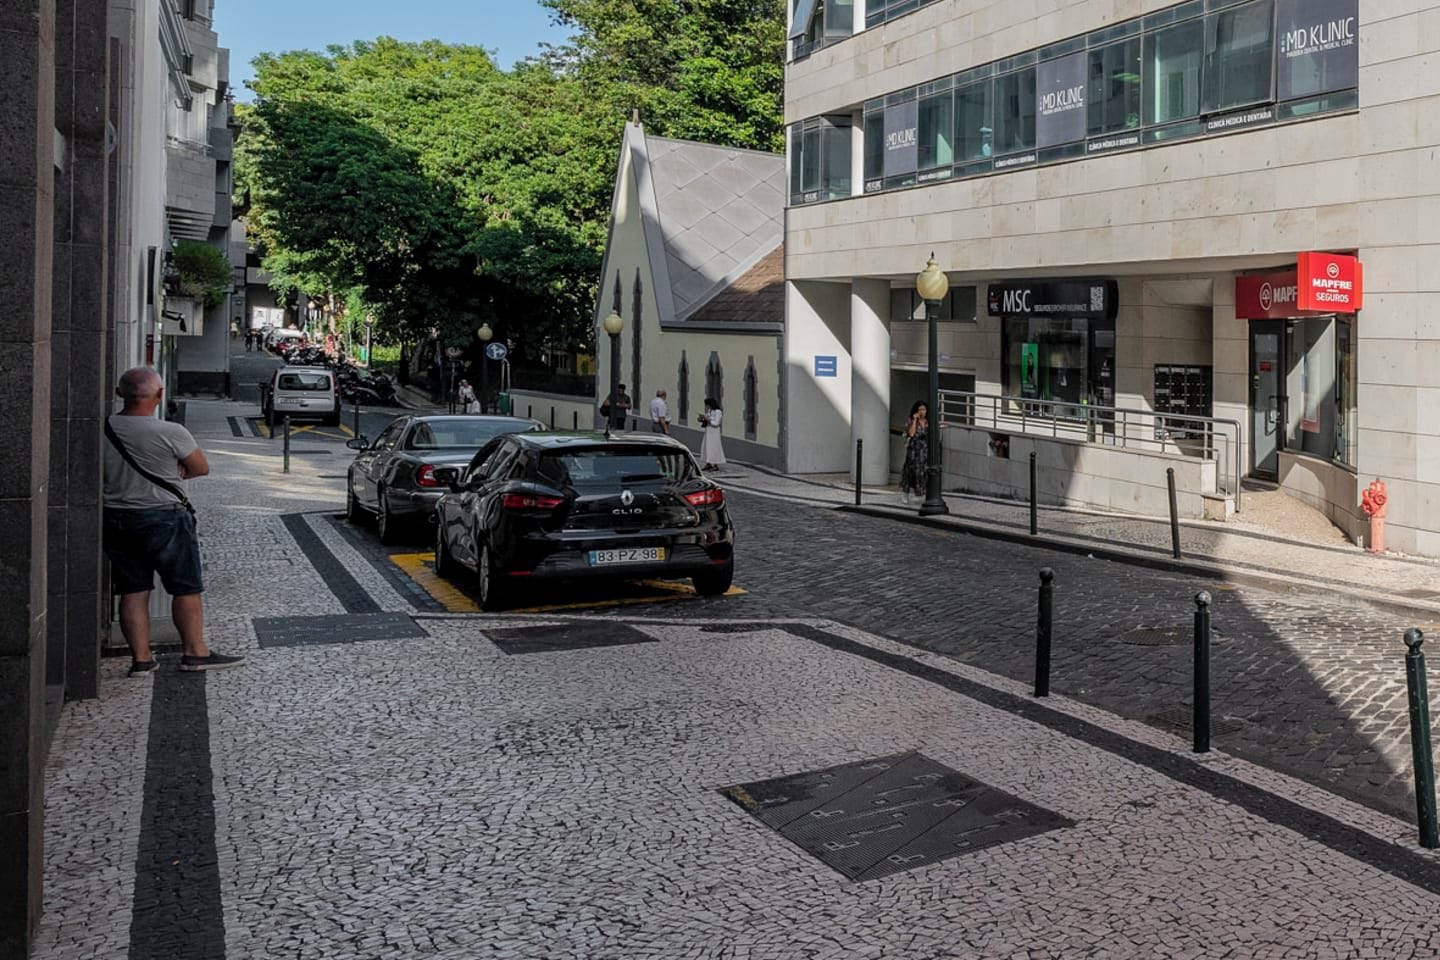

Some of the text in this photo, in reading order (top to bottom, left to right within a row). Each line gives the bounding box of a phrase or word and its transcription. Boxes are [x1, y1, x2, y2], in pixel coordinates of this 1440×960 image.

[1287, 17, 1354, 51] MD KLINIC
[1042, 93, 1056, 110] MD
[1056, 85, 1084, 107] KLINIC
[1312, 278, 1353, 290] MAPFRE
[1002, 289, 1031, 313] MSC
[1315, 292, 1349, 303] SEGUROS
